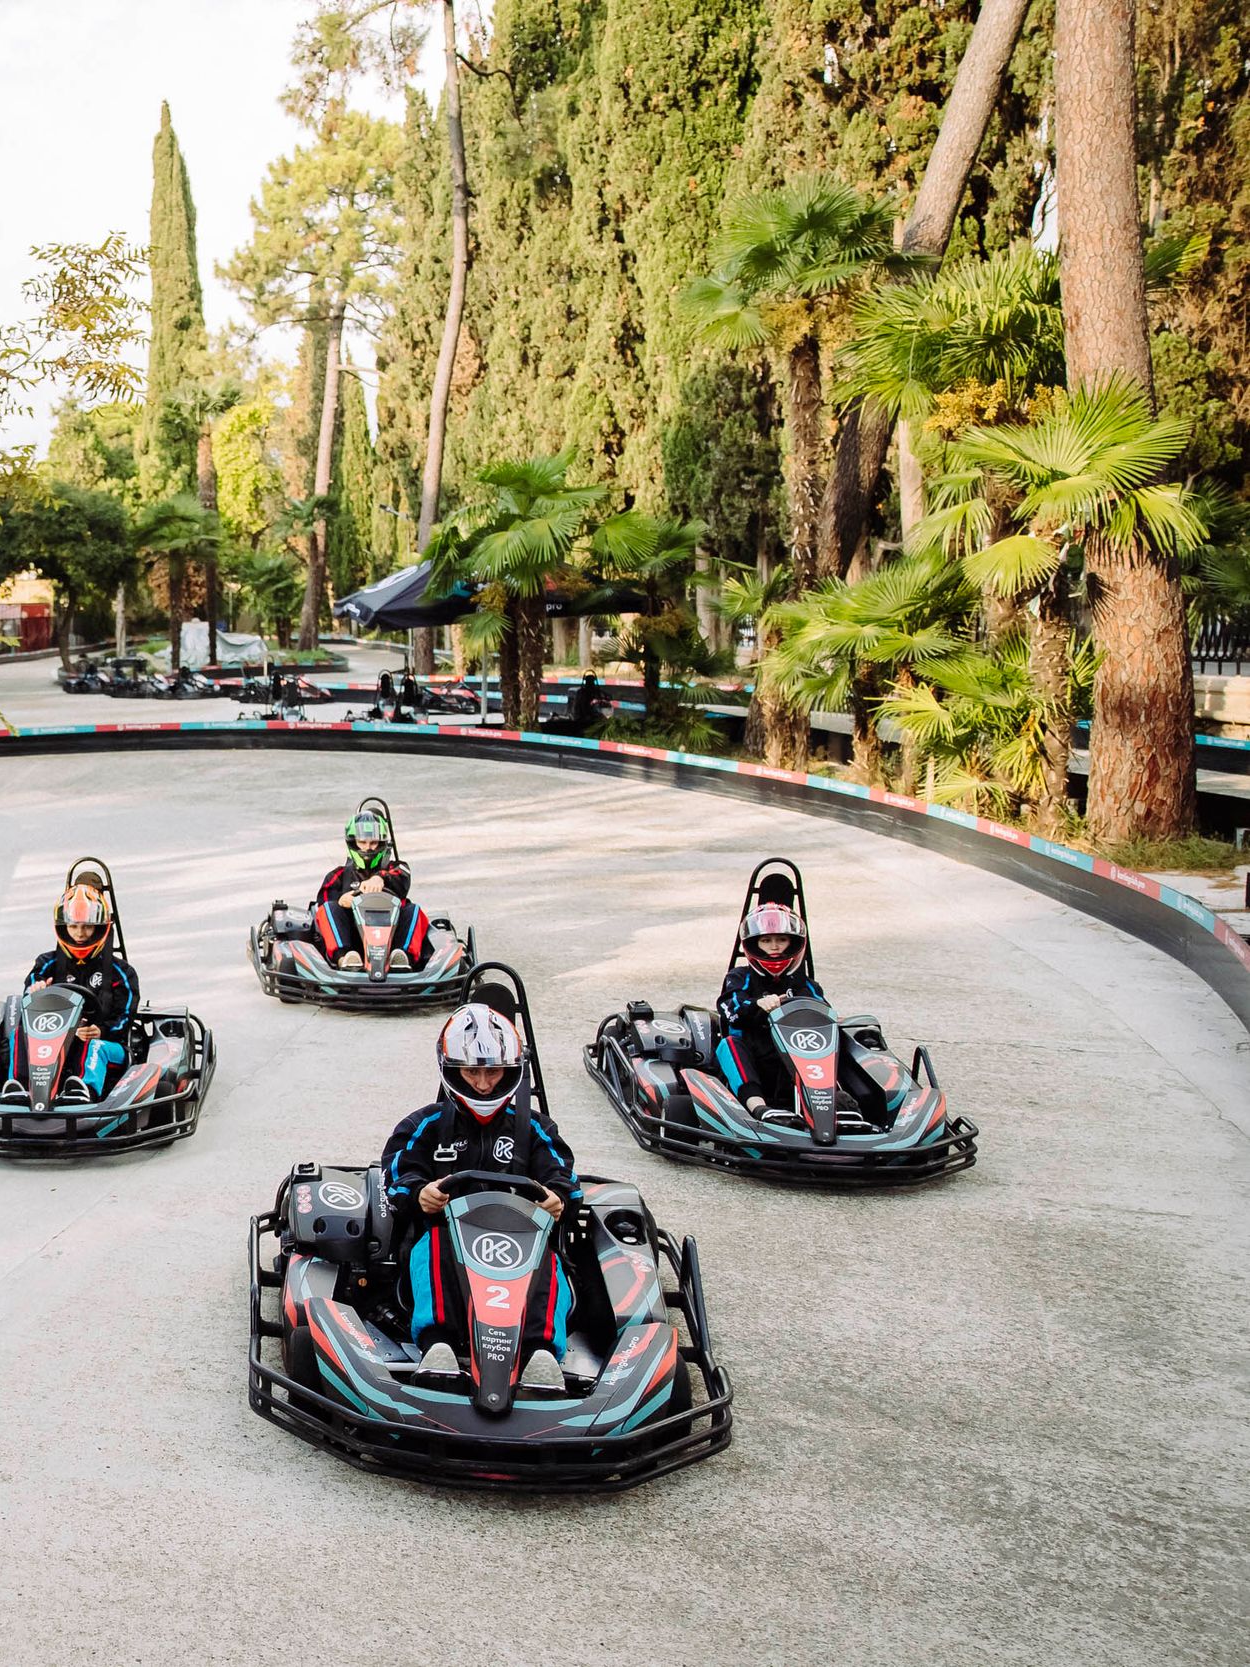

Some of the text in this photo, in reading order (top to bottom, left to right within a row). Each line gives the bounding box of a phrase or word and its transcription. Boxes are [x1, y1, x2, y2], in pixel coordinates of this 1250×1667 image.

[37, 1045, 53, 1059] 9
[806, 1064, 825, 1080] 3
[485, 1285, 511, 1309] 2
[488, 1328, 507, 1337] Сеть
[481, 1335, 513, 1346] картинг
[482, 1342, 511, 1353] клубов
[487, 1353, 505, 1362] PRO
[604, 1335, 640, 1387] kartingclub.pro
